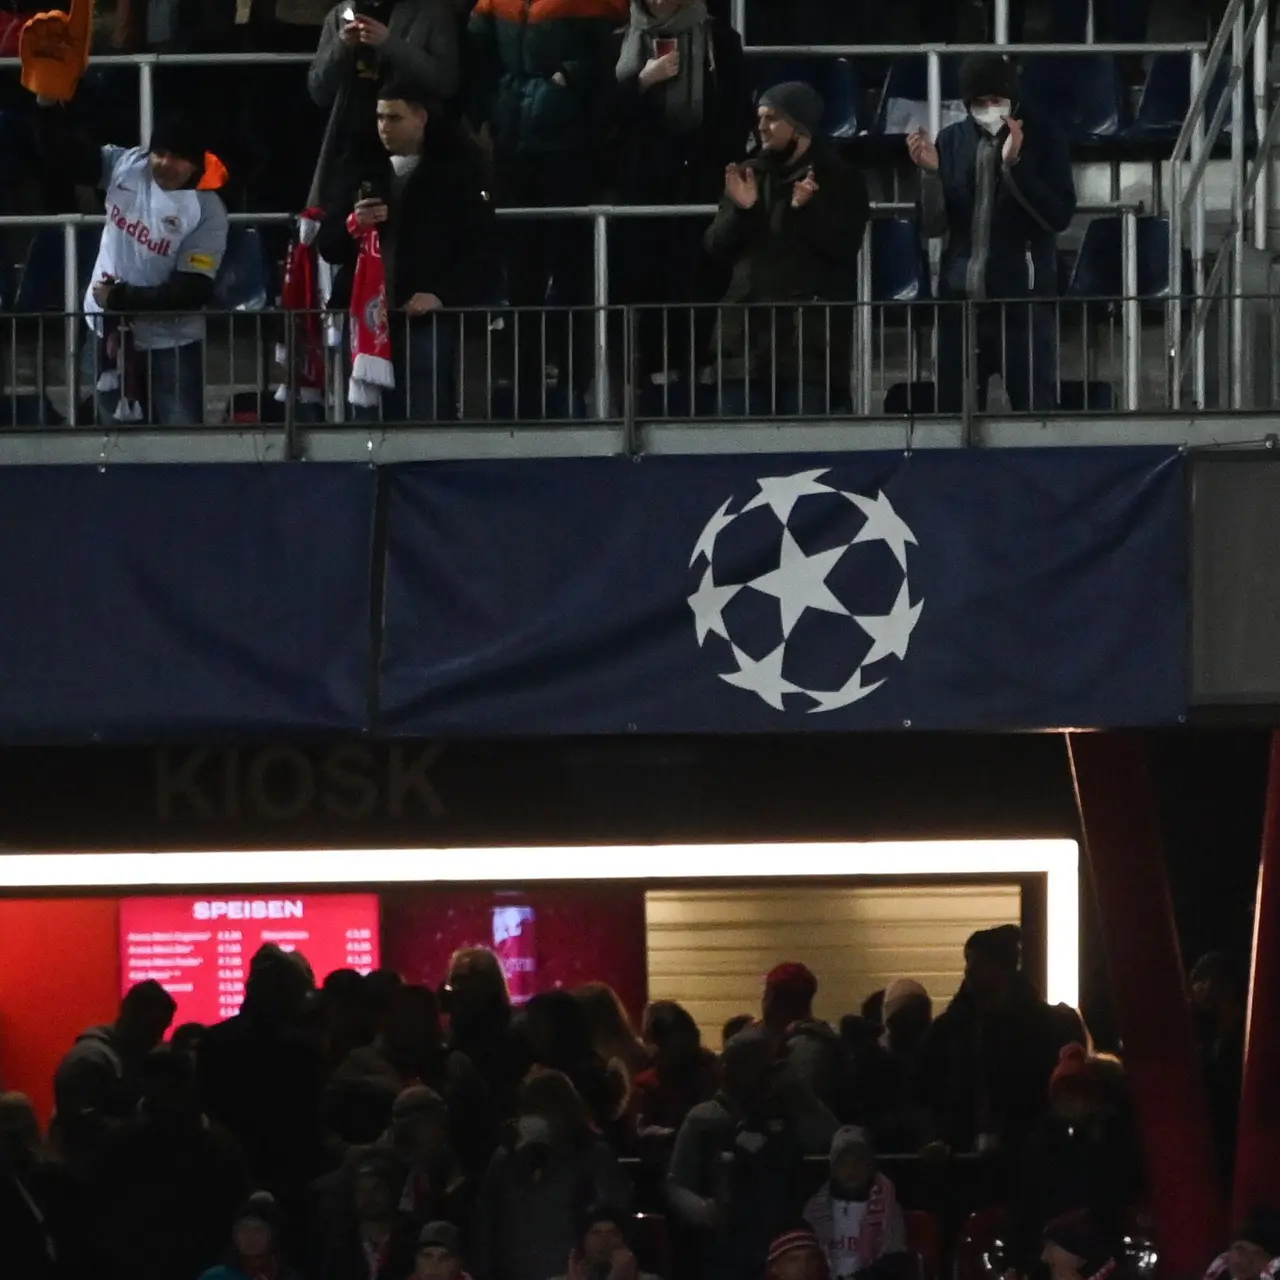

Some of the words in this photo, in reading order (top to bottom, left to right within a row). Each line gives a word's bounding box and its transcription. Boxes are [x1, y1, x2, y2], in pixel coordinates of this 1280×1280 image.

[111, 204, 140, 237] Red
[137, 226, 171, 256] Bull
[155, 745, 447, 821] KIOSK
[192, 900, 304, 919] SPEISEN
